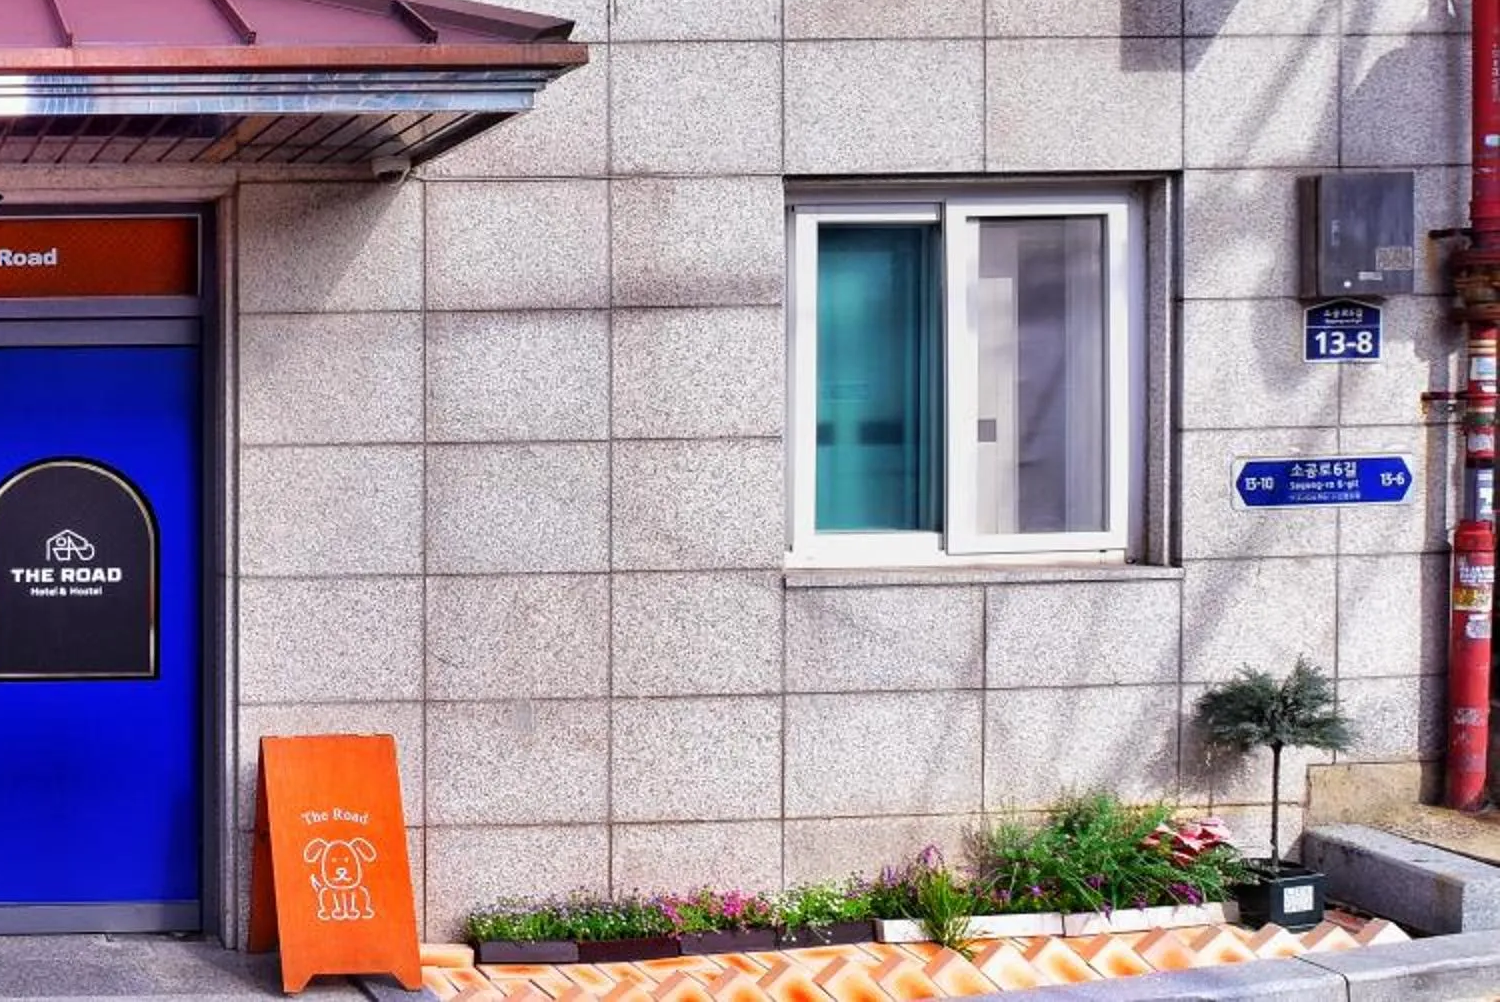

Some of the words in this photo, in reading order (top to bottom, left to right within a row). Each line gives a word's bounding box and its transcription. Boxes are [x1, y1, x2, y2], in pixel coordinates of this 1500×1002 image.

[1315, 331, 1373, 354] 13-8
[11, 568, 55, 583] THE
[61, 567, 122, 583] ROAD
[30, 586, 58, 596] Hotel
[59, 587, 67, 596] &
[70, 586, 103, 596] Hostel
[301, 810, 328, 826] The
[332, 807, 369, 826] Road
